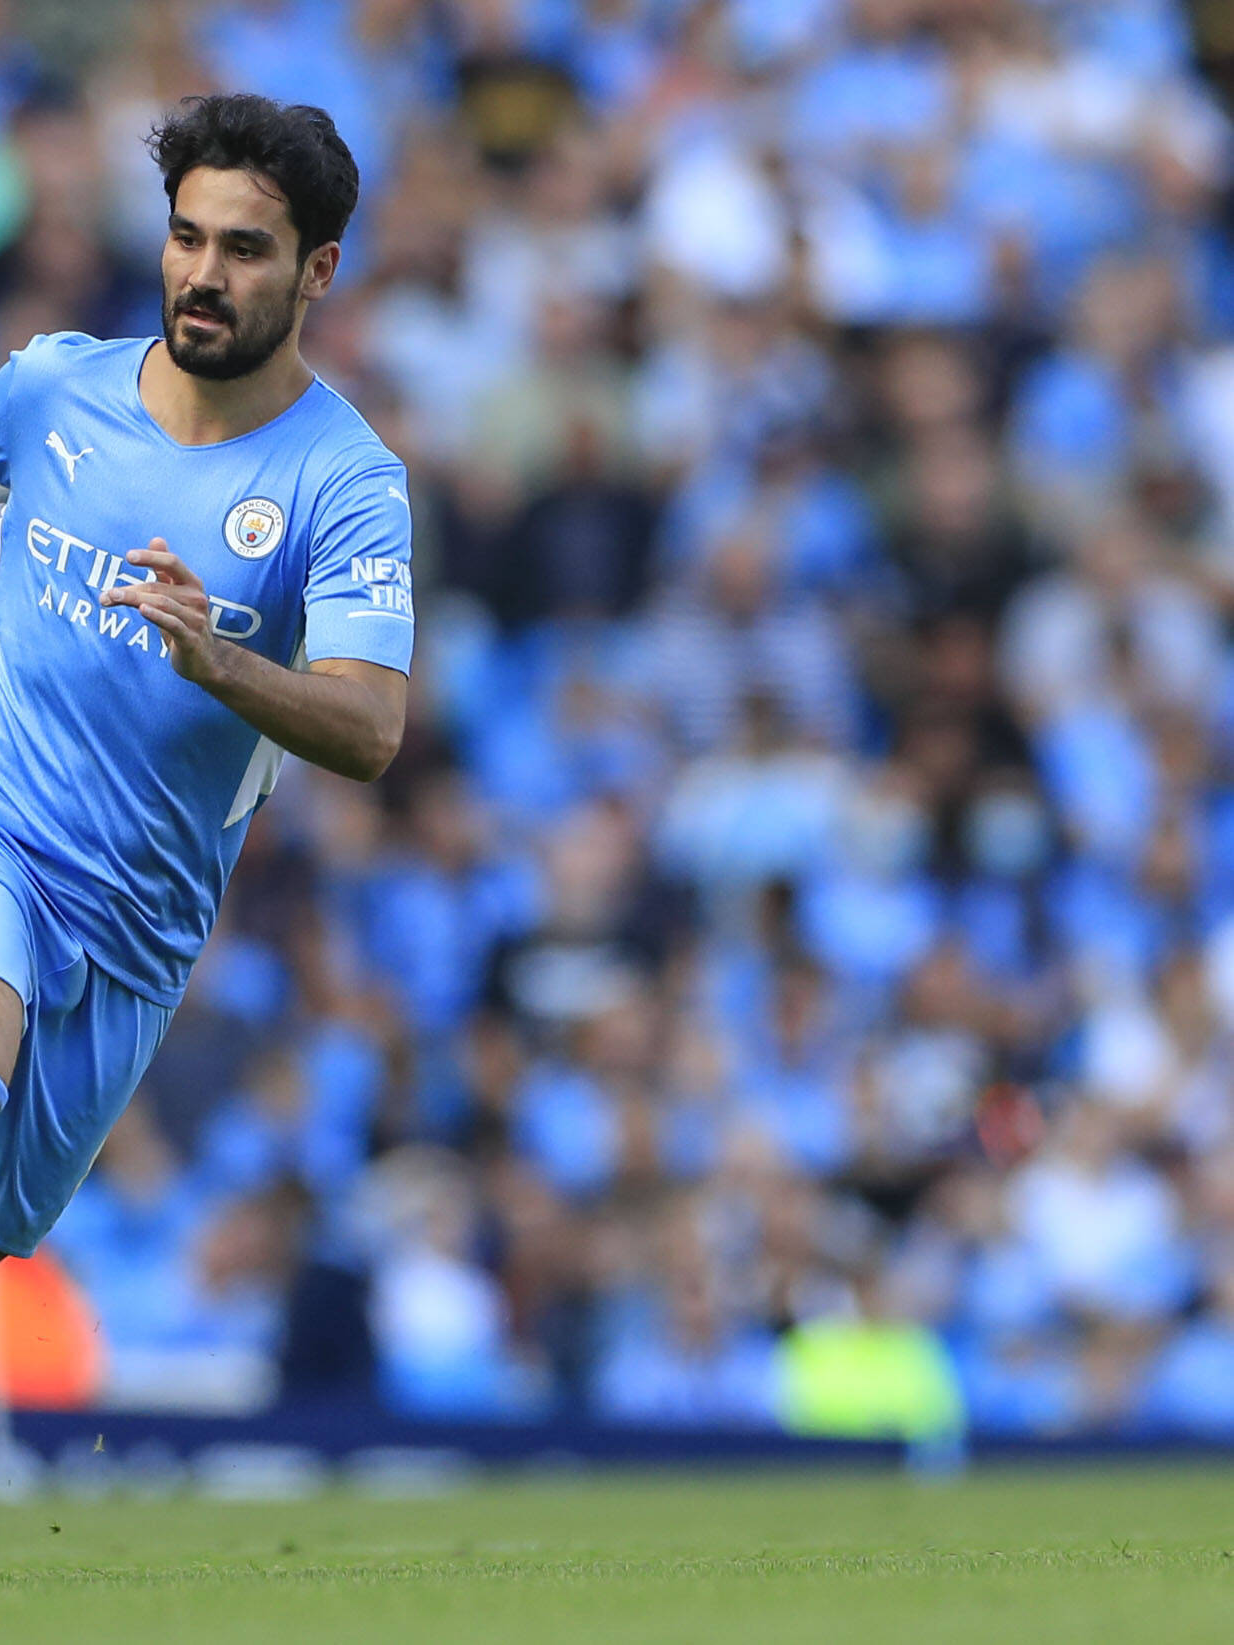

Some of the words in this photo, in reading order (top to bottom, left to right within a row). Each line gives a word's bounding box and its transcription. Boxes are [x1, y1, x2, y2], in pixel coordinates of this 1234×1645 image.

[236, 501, 281, 526] MANCHESTER
[237, 546, 256, 556] CITY
[27, 518, 263, 640] ETIHD
[351, 557, 412, 588] NEX
[38, 584, 170, 658] AIRWAY
